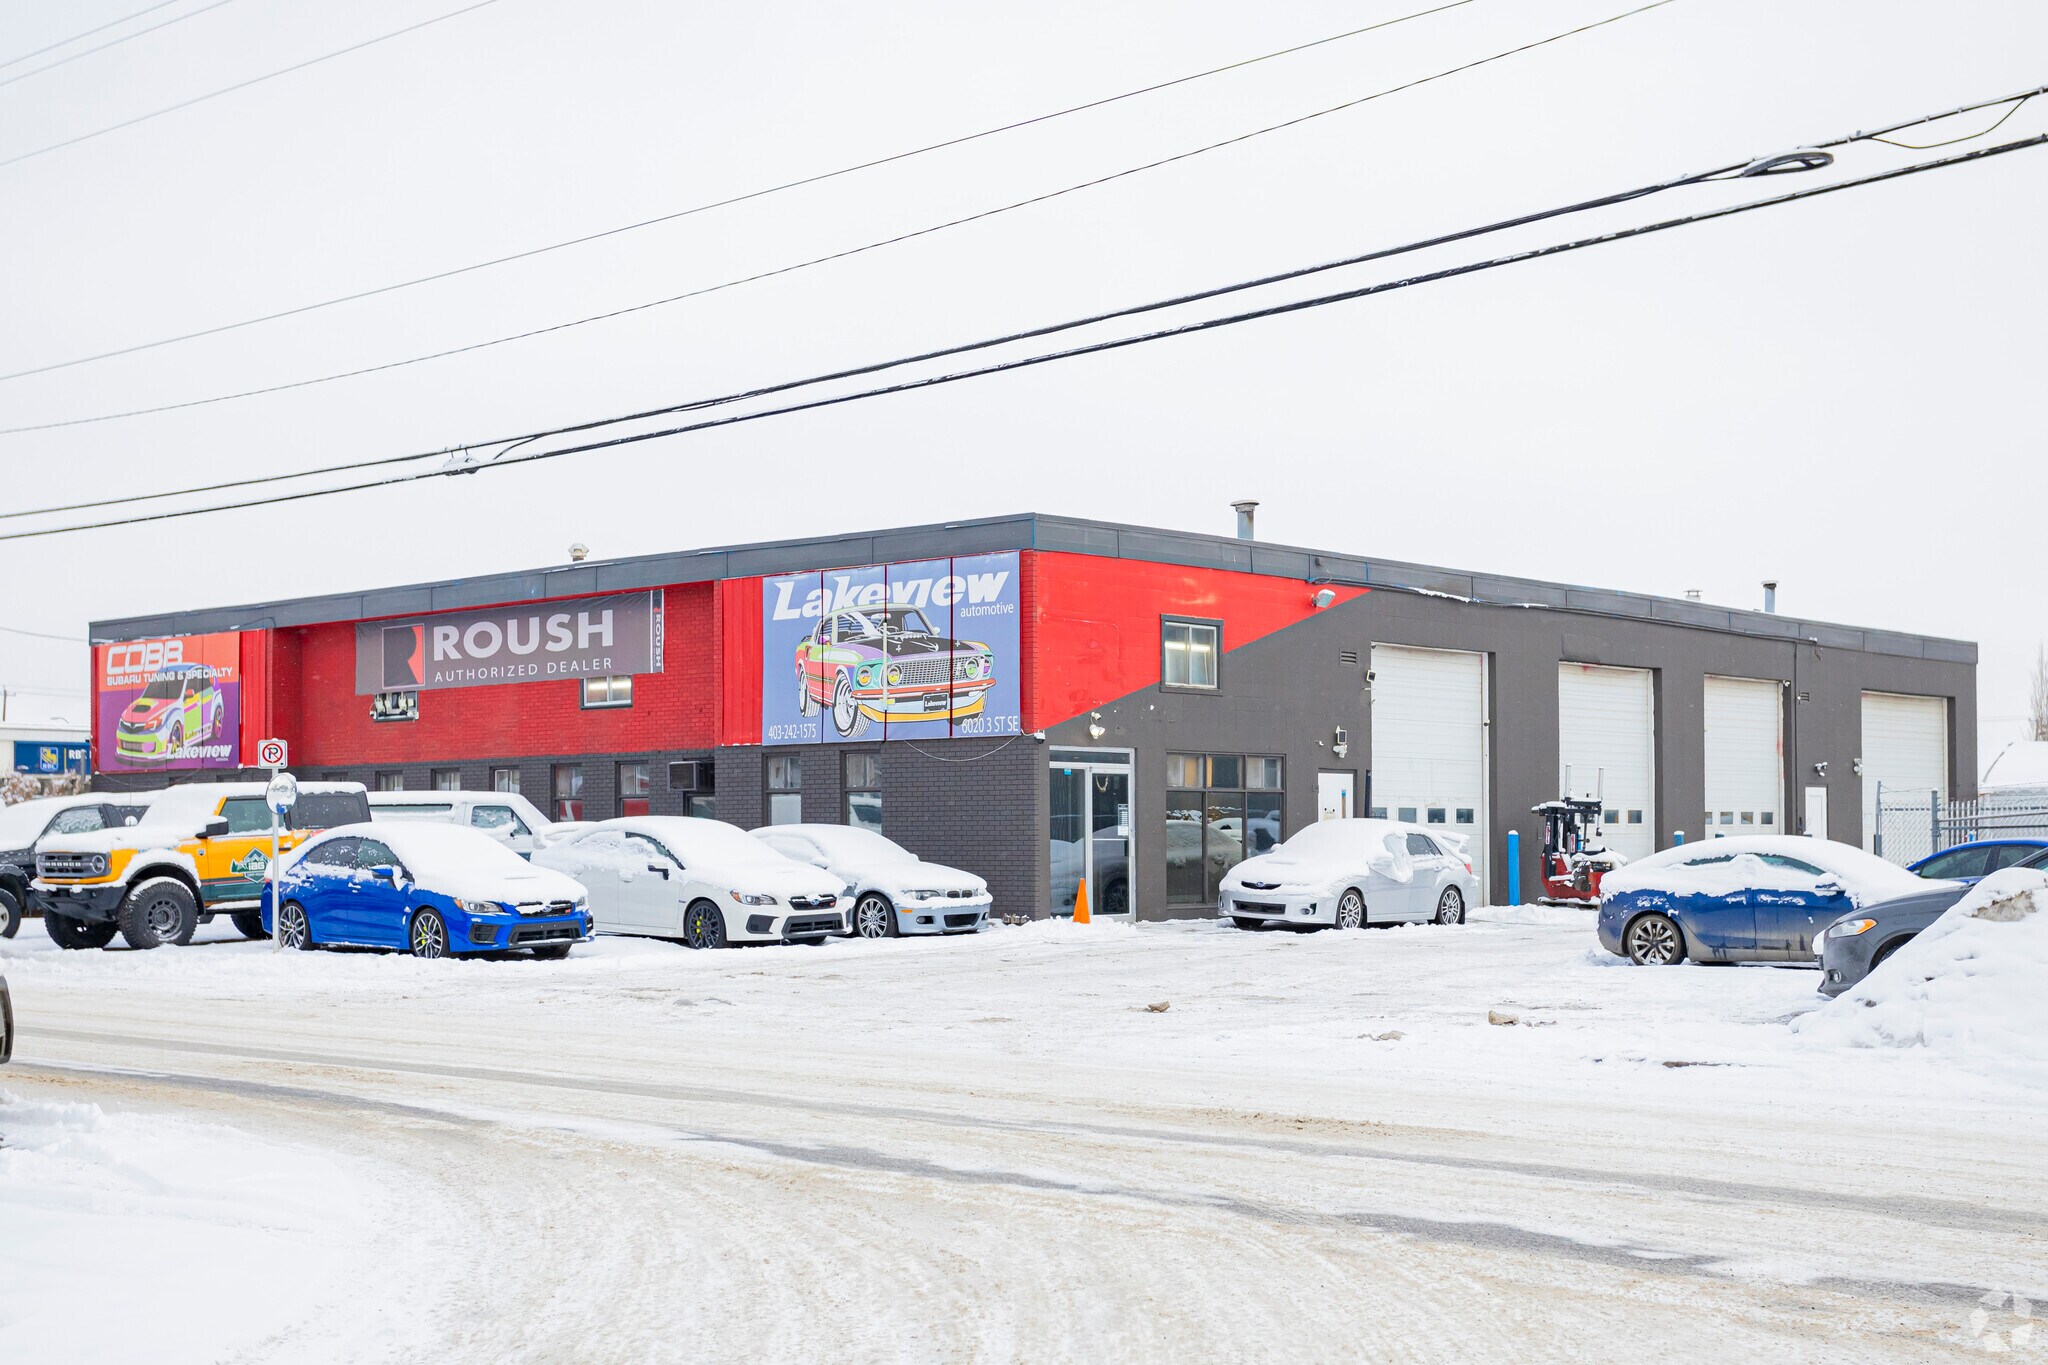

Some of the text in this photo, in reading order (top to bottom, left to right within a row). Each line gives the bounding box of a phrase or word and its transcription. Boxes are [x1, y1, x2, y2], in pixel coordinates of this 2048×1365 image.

[772, 571, 1010, 621] Lakeview
[960, 602, 1014, 618] automotive
[433, 609, 614, 661] ROUSH
[107, 640, 184, 675] COBB
[107, 667, 233, 686] SUBARU TUNING & SPECIALTY
[434, 657, 613, 683] AUTHORIZED DEALER
[768, 723, 817, 740] 403-242-1575
[961, 715, 1019, 734] 6020 3 ST SE
[68, 749, 87, 759] RB
[166, 743, 232, 760] Lakeview
